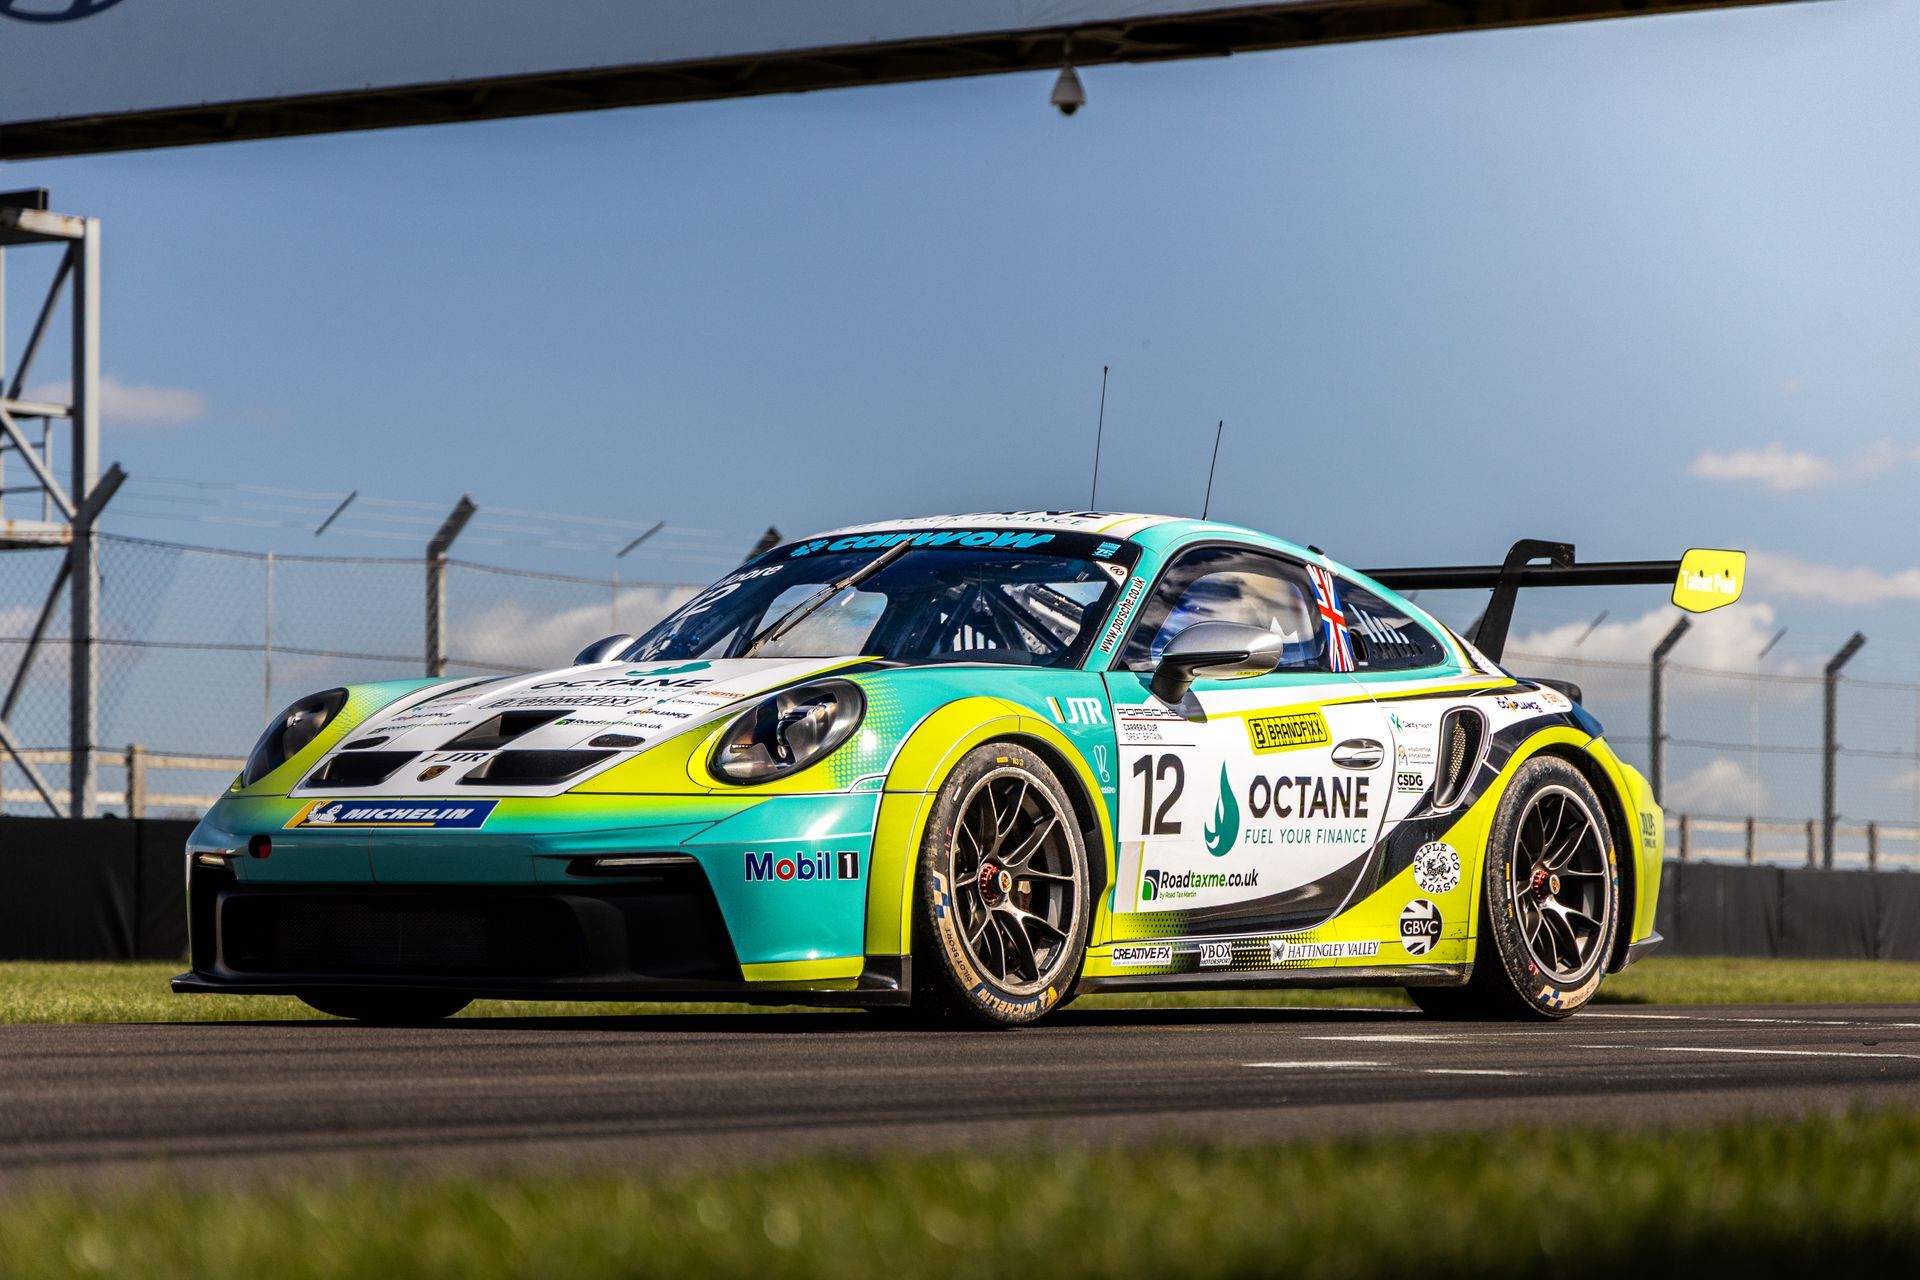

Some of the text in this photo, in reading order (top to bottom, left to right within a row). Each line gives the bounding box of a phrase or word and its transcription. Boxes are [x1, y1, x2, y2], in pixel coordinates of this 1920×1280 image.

[974, 515, 1089, 526] FINANCE
[827, 531, 1056, 552] carwow
[1100, 577, 1145, 653] www.porsche.co.uk
[530, 679, 713, 689] OCTANE
[1066, 697, 1108, 724] JTR
[1117, 708, 1178, 717] PORSCHE
[571, 718, 663, 730] Roadtaxme.co.uk
[1123, 723, 1158, 731] CARRERA CUP
[1267, 719, 1324, 740] BRANDFIXX
[434, 752, 490, 762] JTR
[1397, 774, 1424, 786] CSDG
[1133, 753, 1185, 835] 12
[1248, 775, 1370, 819] OCTANE
[340, 808, 475, 820] MICHELIN
[1244, 828, 1367, 844] FUEL YOUR FINANCE
[744, 851, 831, 881] Mobil
[1414, 843, 1460, 873] TRIPLE CO
[1160, 868, 1259, 889] Roadtaxme.co.uk
[1420, 876, 1459, 893] ROAST
[1159, 891, 1165, 899] by
[1165, 890, 1176, 899] Road
[1184, 890, 1197, 898] Martin
[1403, 920, 1439, 935] GBVC
[944, 927, 973, 985] PILOT SPORT
[1113, 946, 1171, 960] CREATIVE FX
[1200, 943, 1232, 958] VBOX
[1287, 941, 1380, 958] HATTINGLEY VALLEY
[1200, 957, 1232, 965] MOTORSPORT
[976, 987, 1038, 1015] MICHELIN
